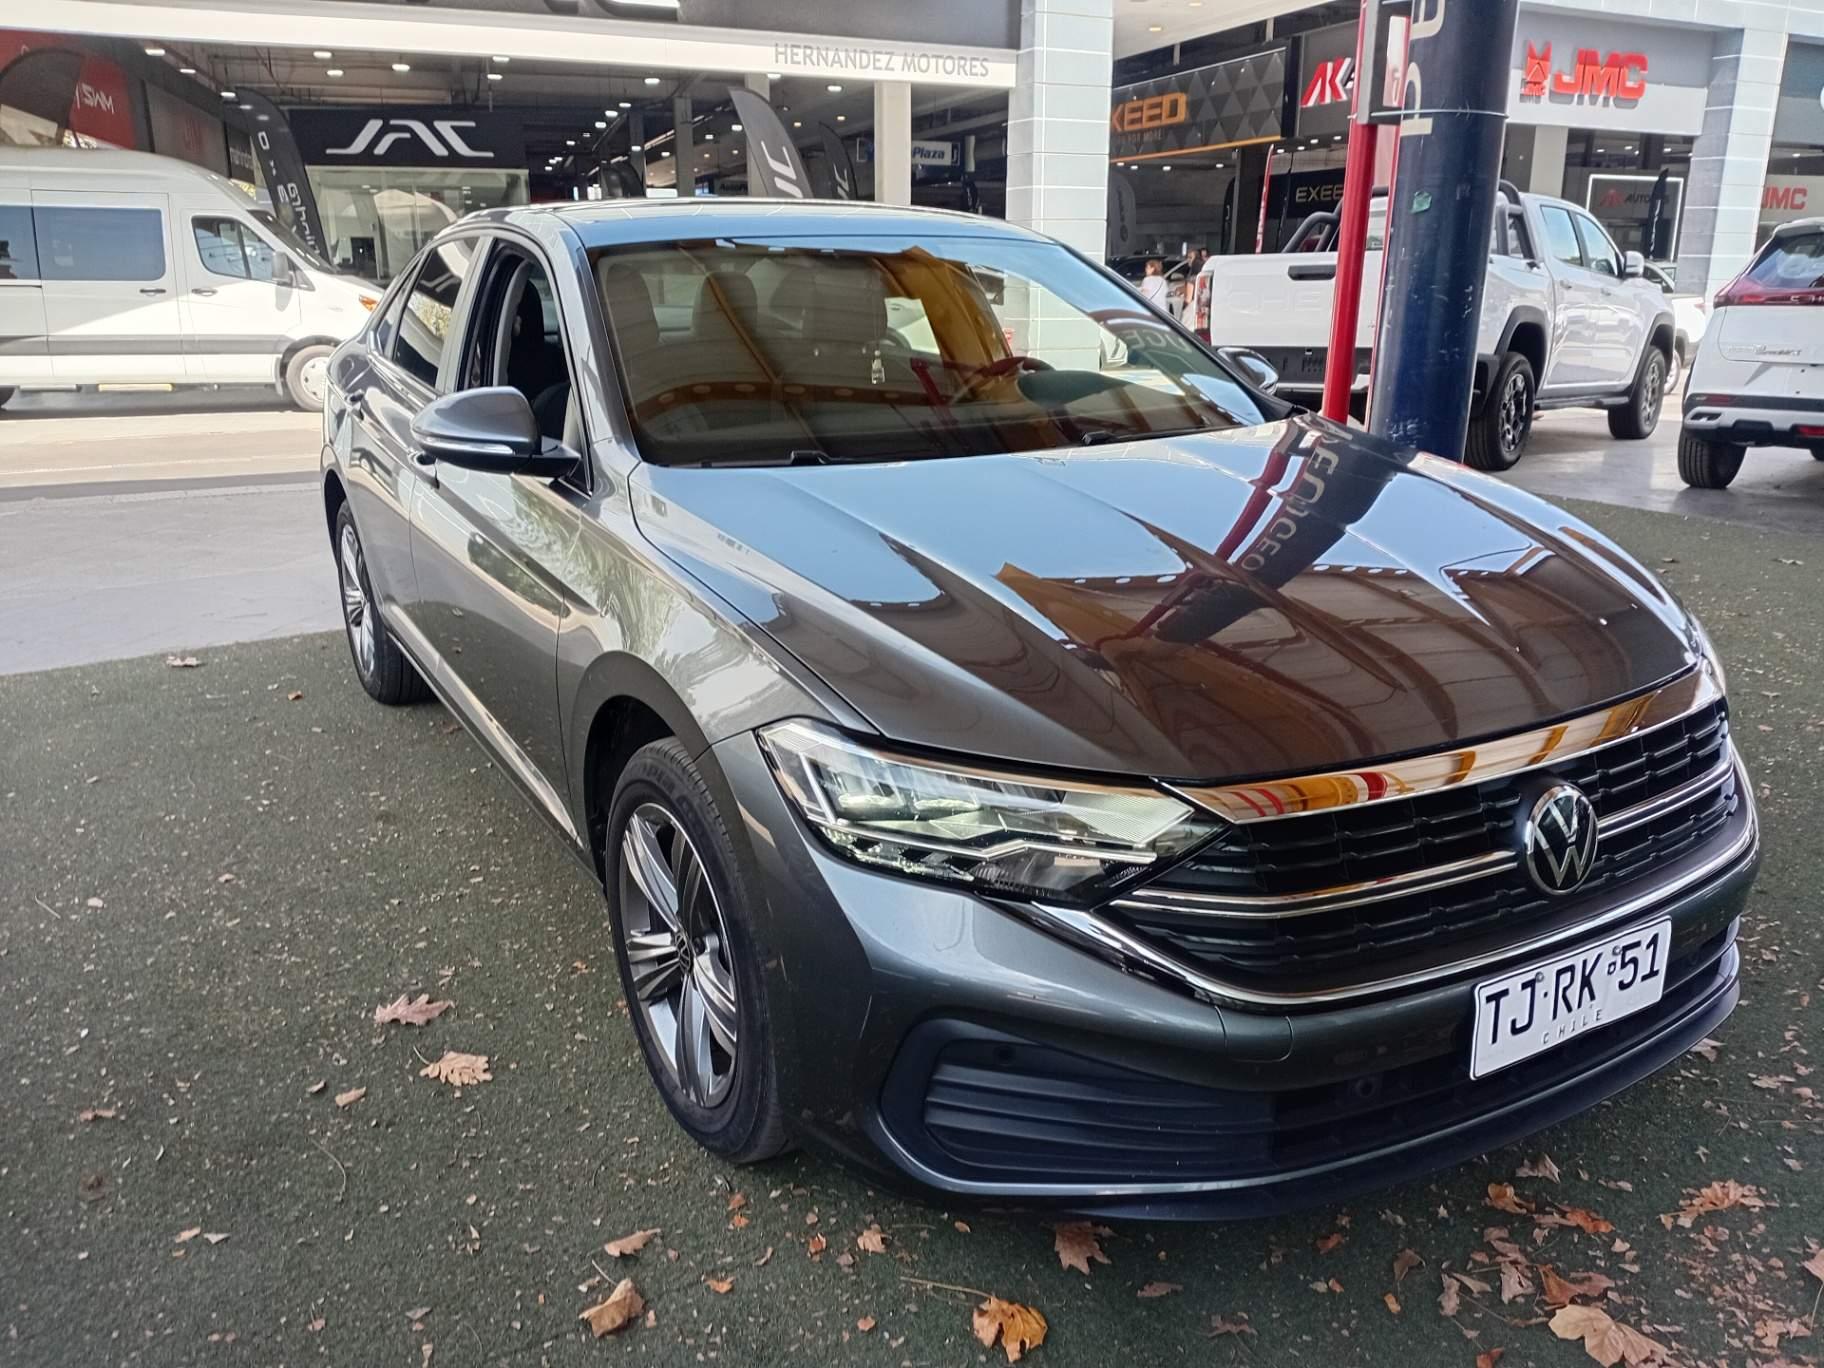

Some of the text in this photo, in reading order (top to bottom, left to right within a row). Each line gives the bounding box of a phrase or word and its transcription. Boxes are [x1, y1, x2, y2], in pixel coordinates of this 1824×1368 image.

[774, 43, 990, 78] HERNANDEZ MOTORES
[1553, 47, 1649, 99] JMC
[325, 118, 495, 158] JAC
[1541, 1007, 1605, 1046] CHILE
